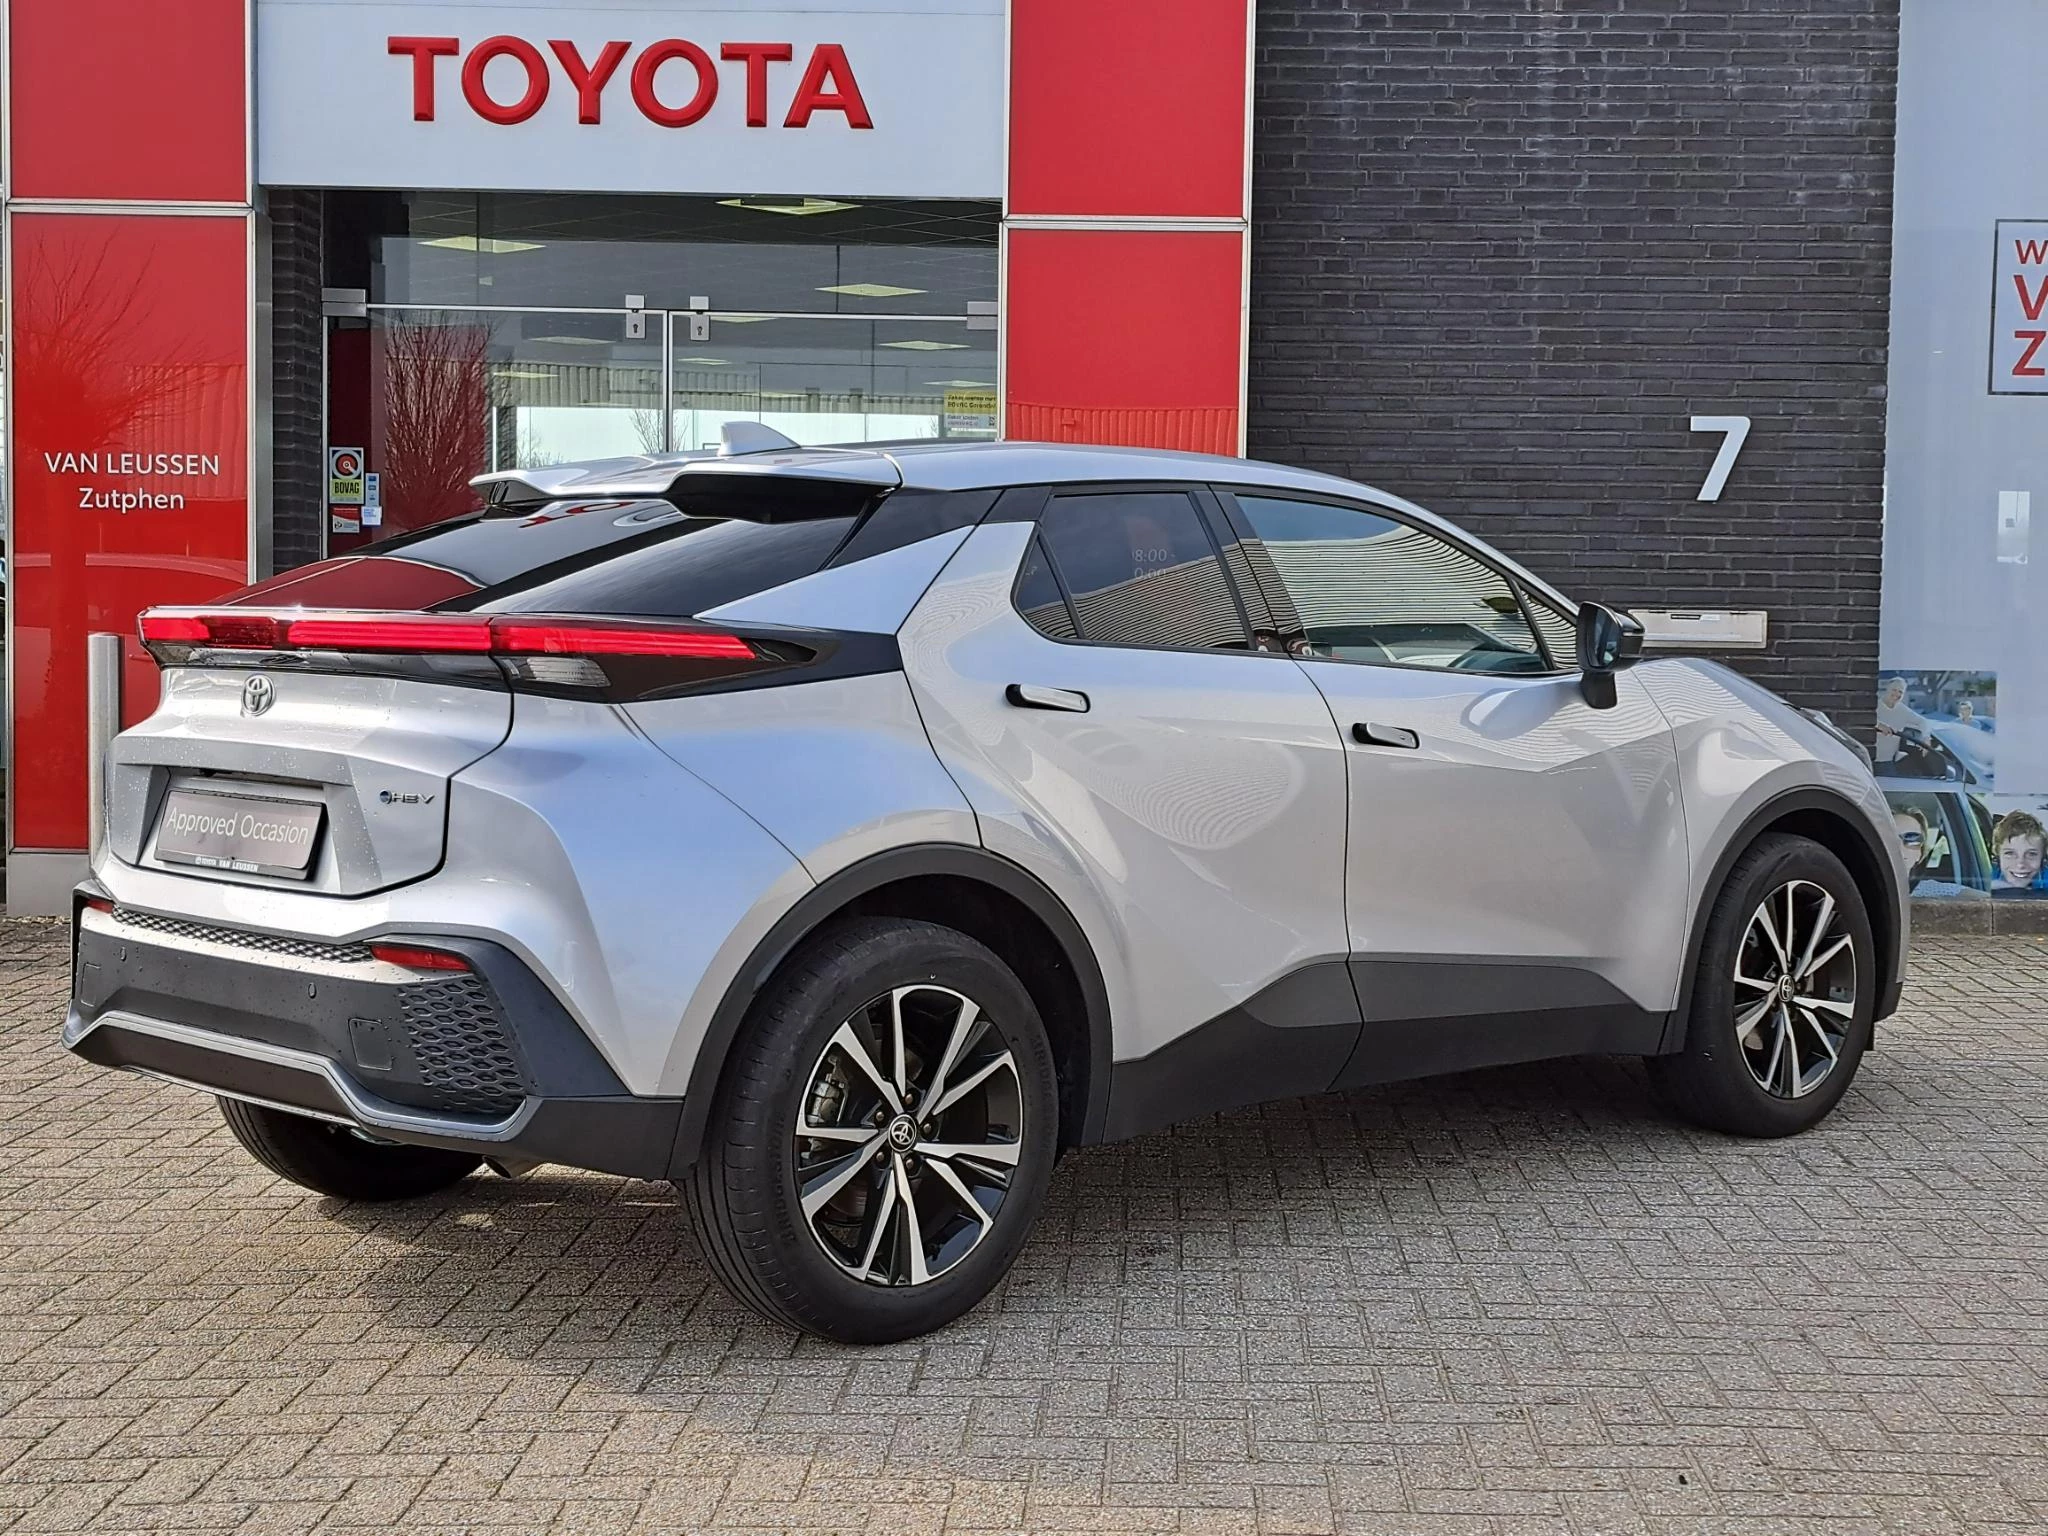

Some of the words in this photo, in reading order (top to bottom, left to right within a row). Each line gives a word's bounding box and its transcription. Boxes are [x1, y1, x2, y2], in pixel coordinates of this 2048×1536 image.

[388, 35, 874, 129] TOYOTA
[44, 452, 98, 474] VAN
[106, 453, 220, 476] LEUSSEN
[1690, 416, 1751, 502] 7
[334, 481, 359, 493] BOVAG
[79, 487, 184, 514] Zutphen
[391, 792, 436, 804] HEV
[166, 806, 238, 837] Approved
[240, 814, 309, 845] Occasion
[218, 859, 231, 868] VAN
[232, 861, 259, 873] LEUSSEN
